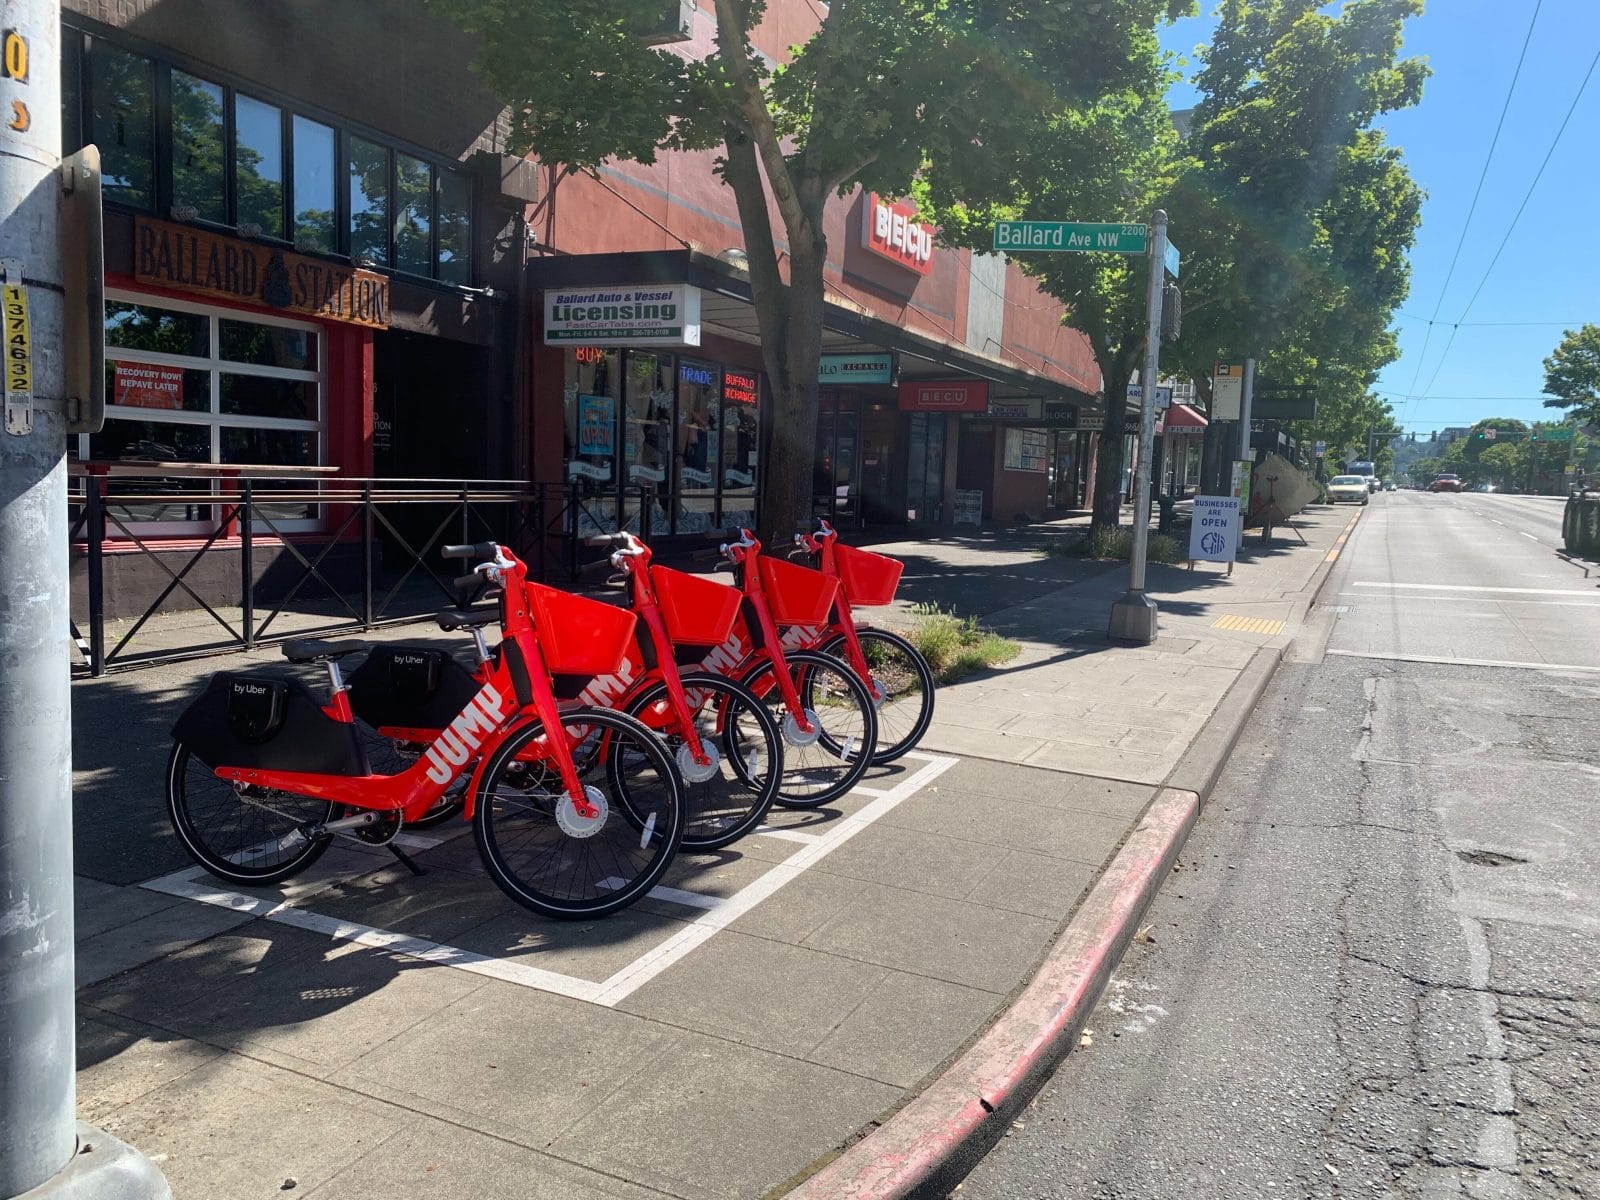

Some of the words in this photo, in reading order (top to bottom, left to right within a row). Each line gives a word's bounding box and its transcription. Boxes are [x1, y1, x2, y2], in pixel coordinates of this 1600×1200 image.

[998, 224, 1063, 246] Ballard
[1068, 234, 1091, 247] Ave
[1097, 233, 1120, 247] NW
[1121, 225, 1145, 236] 2200
[140, 224, 257, 297] BALLARD
[295, 262, 386, 325] STATION
[556, 293, 594, 304] Ballard
[596, 293, 621, 303] Auto
[624, 293, 631, 302] &
[634, 291, 673, 301] Vessel
[552, 302, 676, 322] Licensing
[565, 321, 662, 329] FastCarTabs.com
[576, 347, 600, 363] BUY
[117, 367, 160, 380] RECOVERY
[161, 372, 182, 382] NOW!
[681, 366, 712, 385] TRADE
[725, 373, 754, 390] BUFFALO
[120, 379, 153, 390] REPAVE
[154, 382, 178, 392] LATER
[922, 391, 964, 401] BECU
[1194, 499, 1238, 508] BUSINESSES
[1201, 518, 1227, 527] OPEN
[395, 655, 404, 665] by
[405, 655, 424, 665] Uber
[234, 683, 245, 694] by
[246, 683, 266, 694] Uber
[425, 682, 506, 786] JUMP
